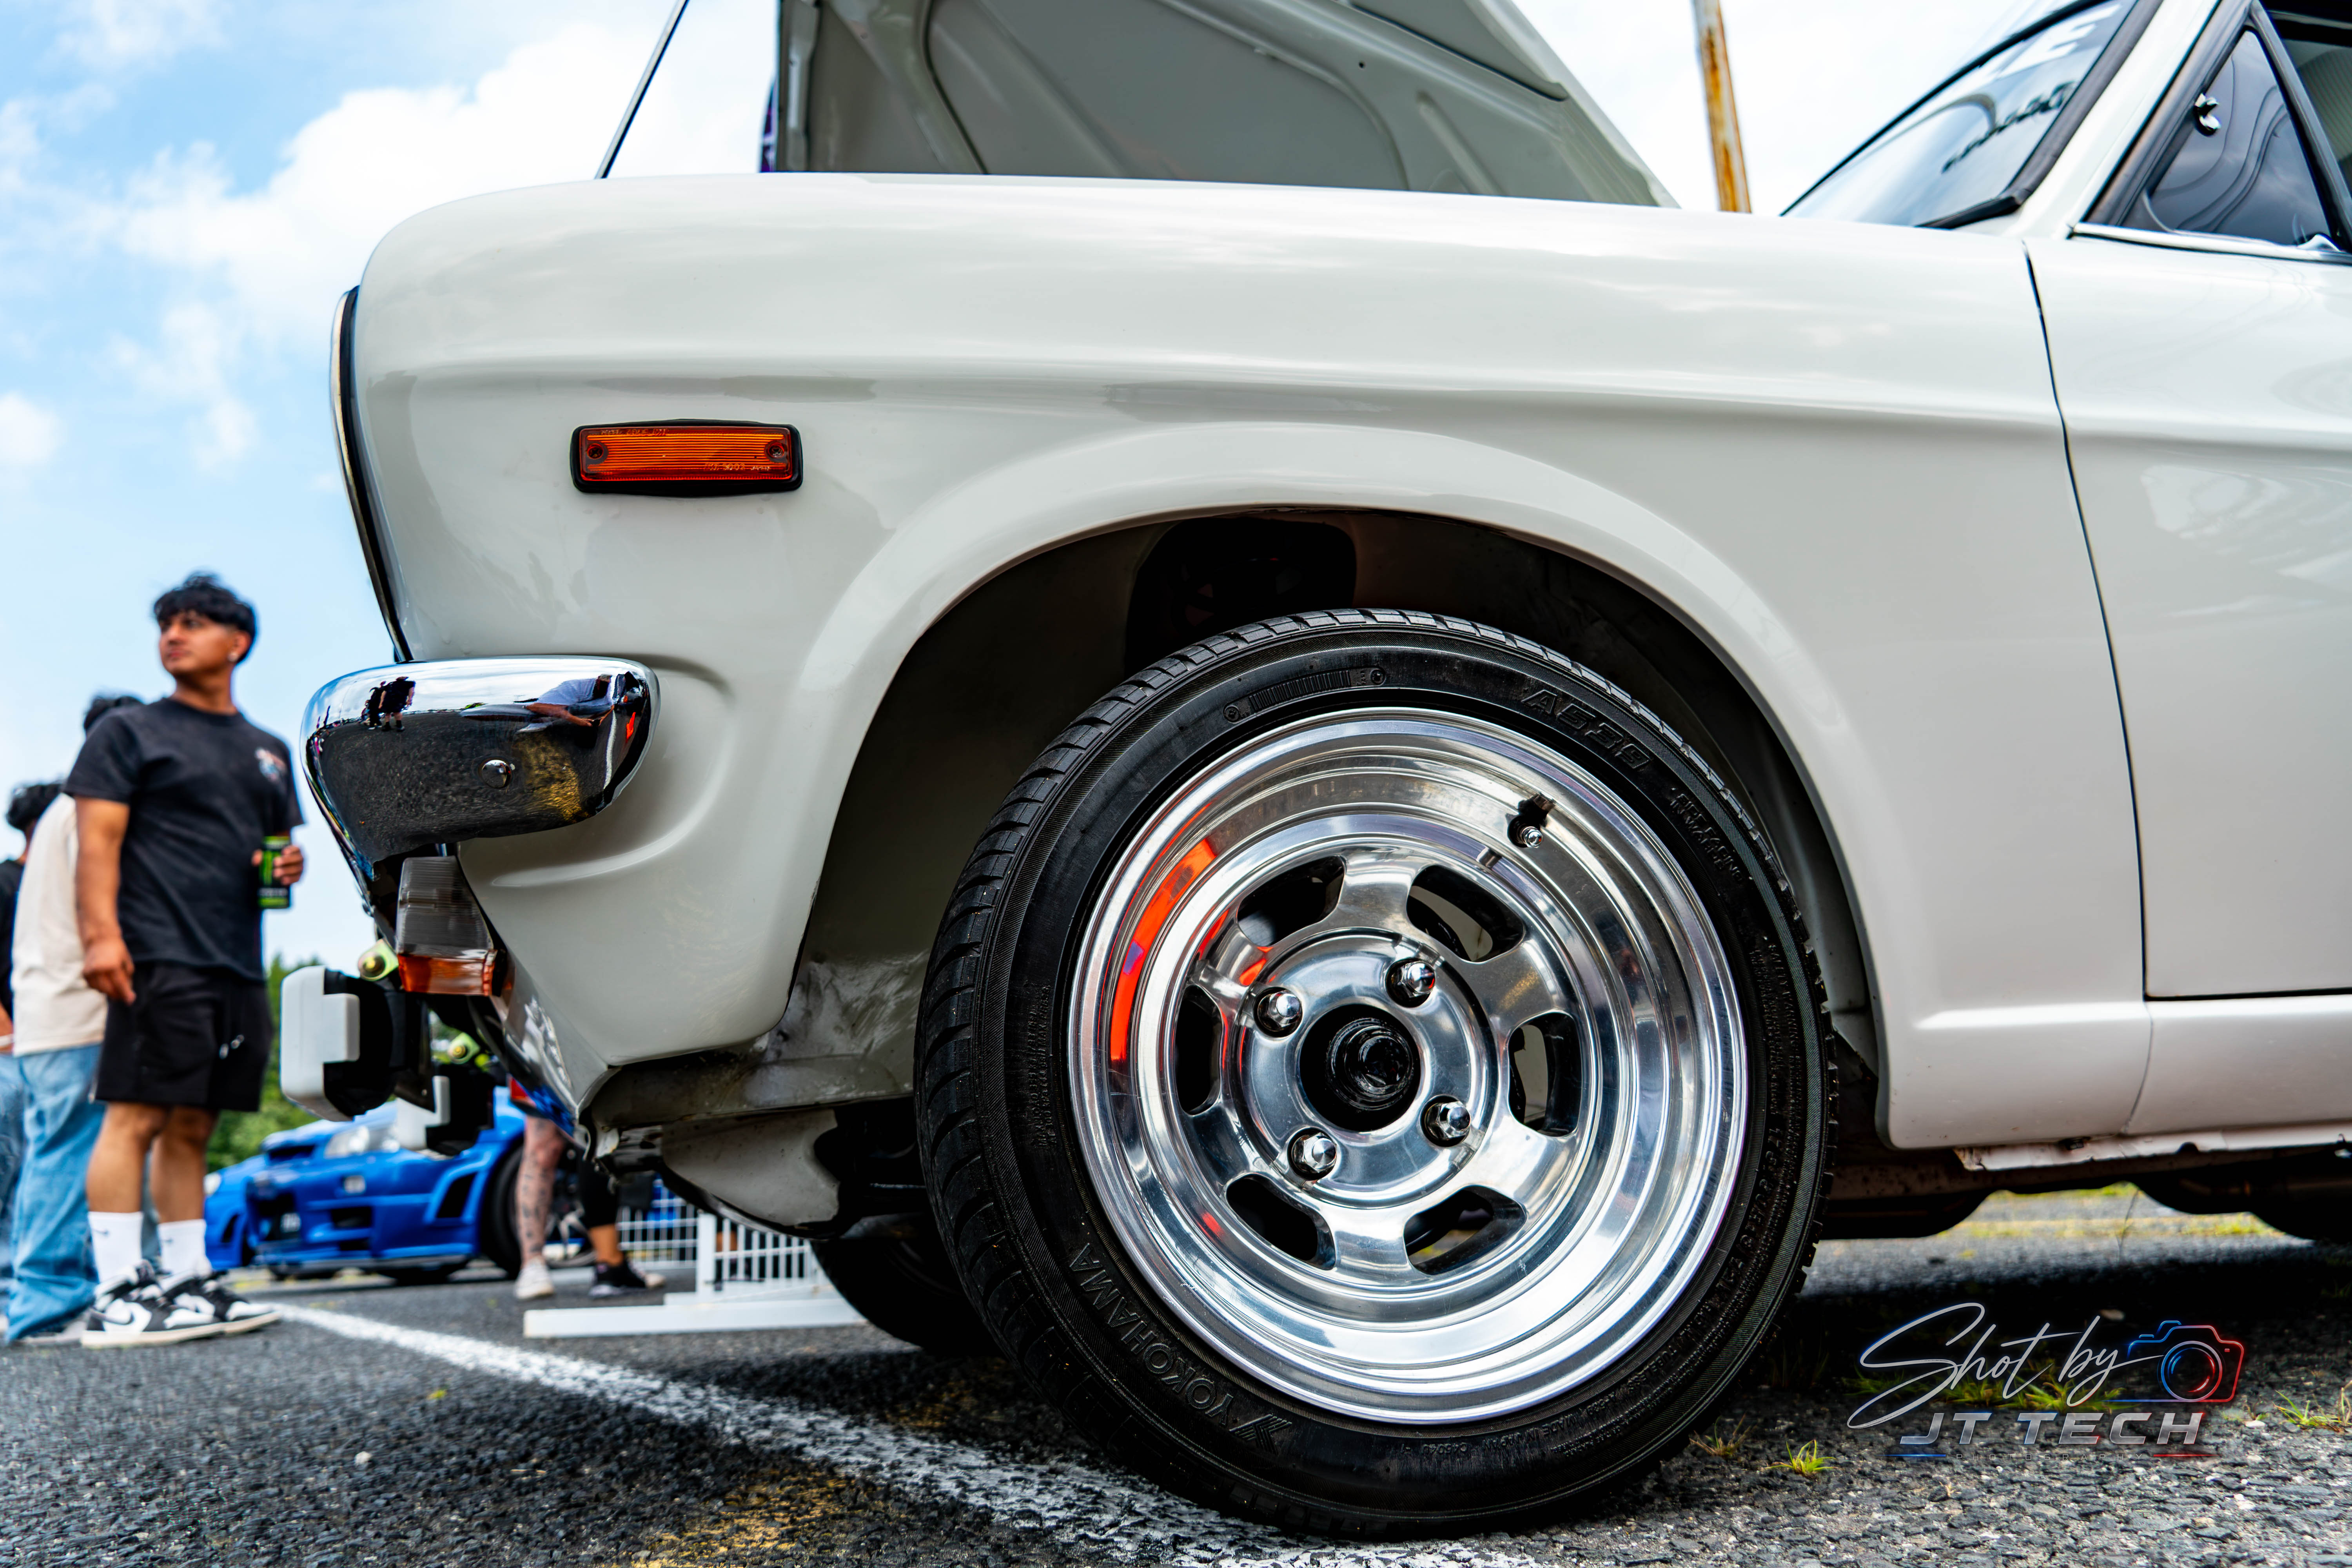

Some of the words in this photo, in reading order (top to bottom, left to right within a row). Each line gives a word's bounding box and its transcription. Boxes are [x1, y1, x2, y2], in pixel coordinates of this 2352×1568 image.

[1521, 689, 1650, 769] A539
[1676, 793, 1708, 823] SIDE
[1704, 827, 1743, 882] FACING
[1069, 1243, 1234, 1428] YOKOHAMA
[1624, 1343, 1678, 1394] TUBELESS
[1480, 1431, 1524, 1451] JAPAN
[1539, 1412, 1578, 1437] MADE
